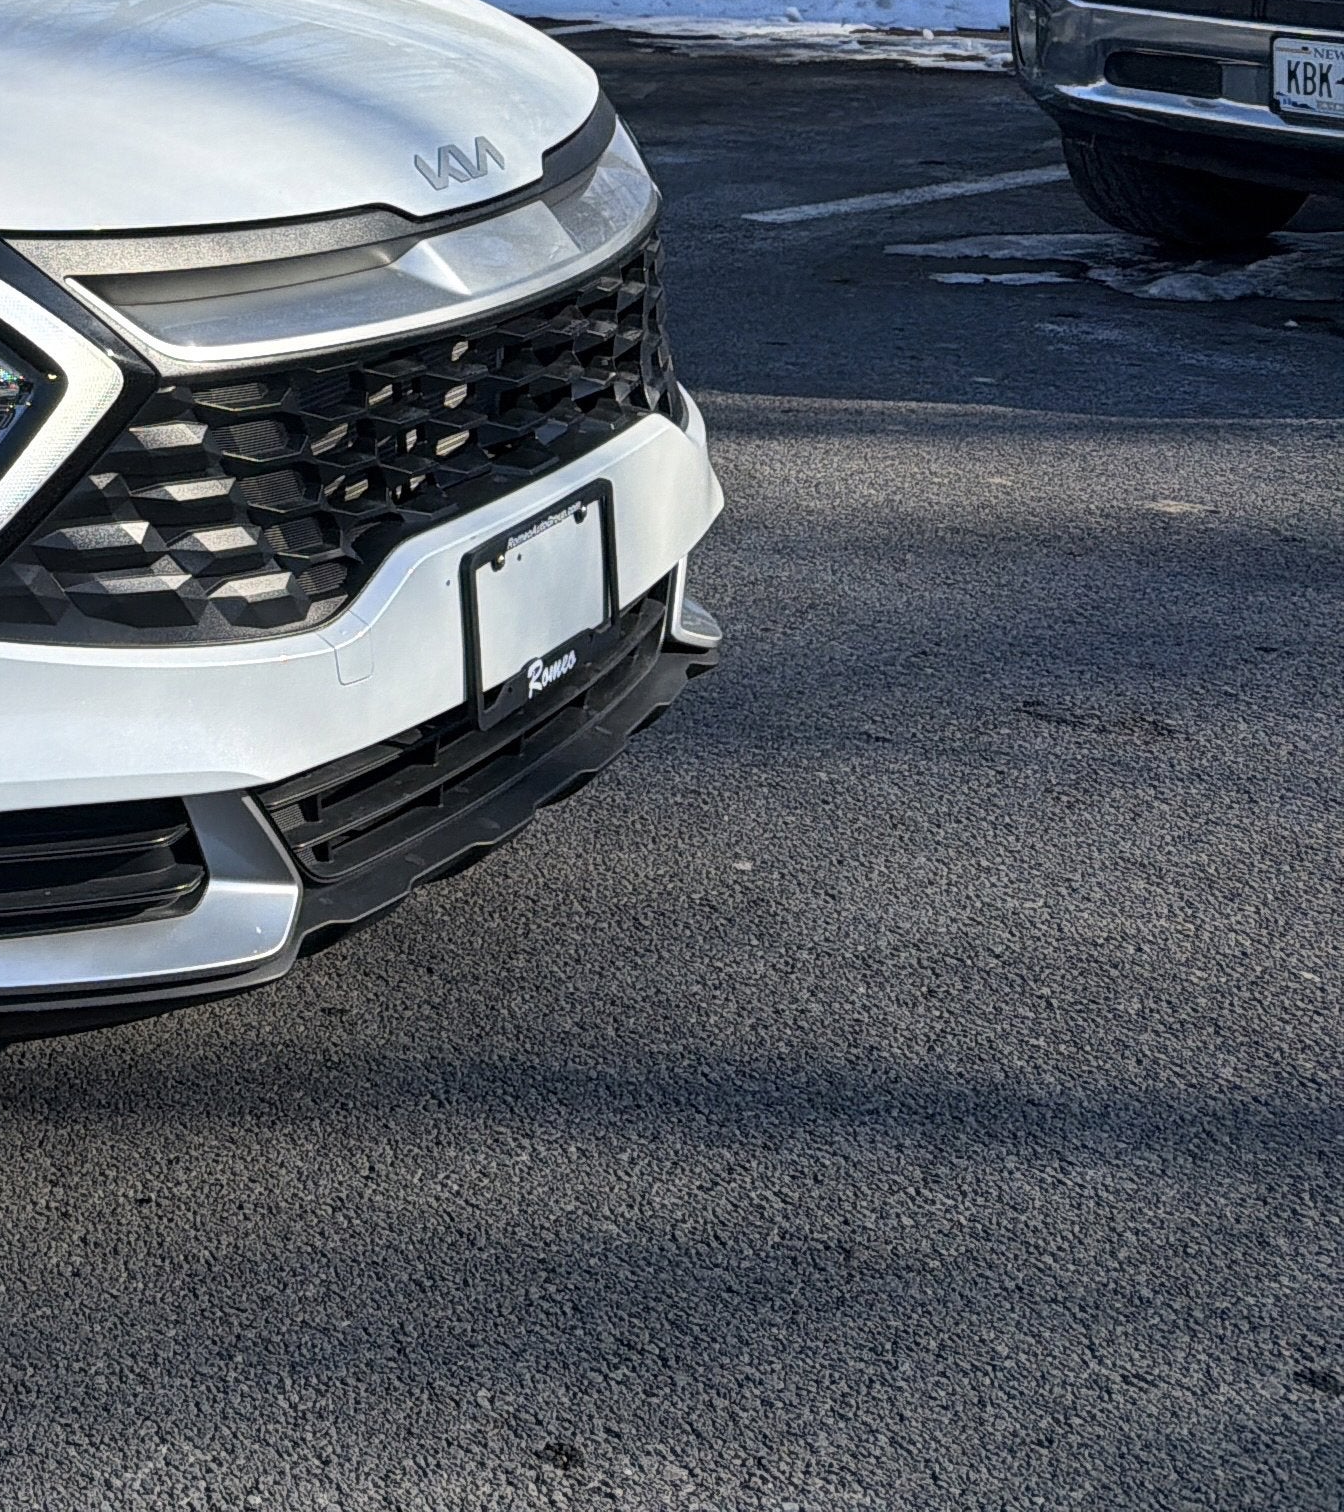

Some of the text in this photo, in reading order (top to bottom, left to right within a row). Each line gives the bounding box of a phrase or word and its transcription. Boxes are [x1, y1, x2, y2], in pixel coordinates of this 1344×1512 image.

[1286, 59, 1332, 98] KBK
[413, 136, 505, 190] KIA
[506, 501, 582, 550] RomeoAutoGroup.com
[526, 650, 577, 699] Romeo
